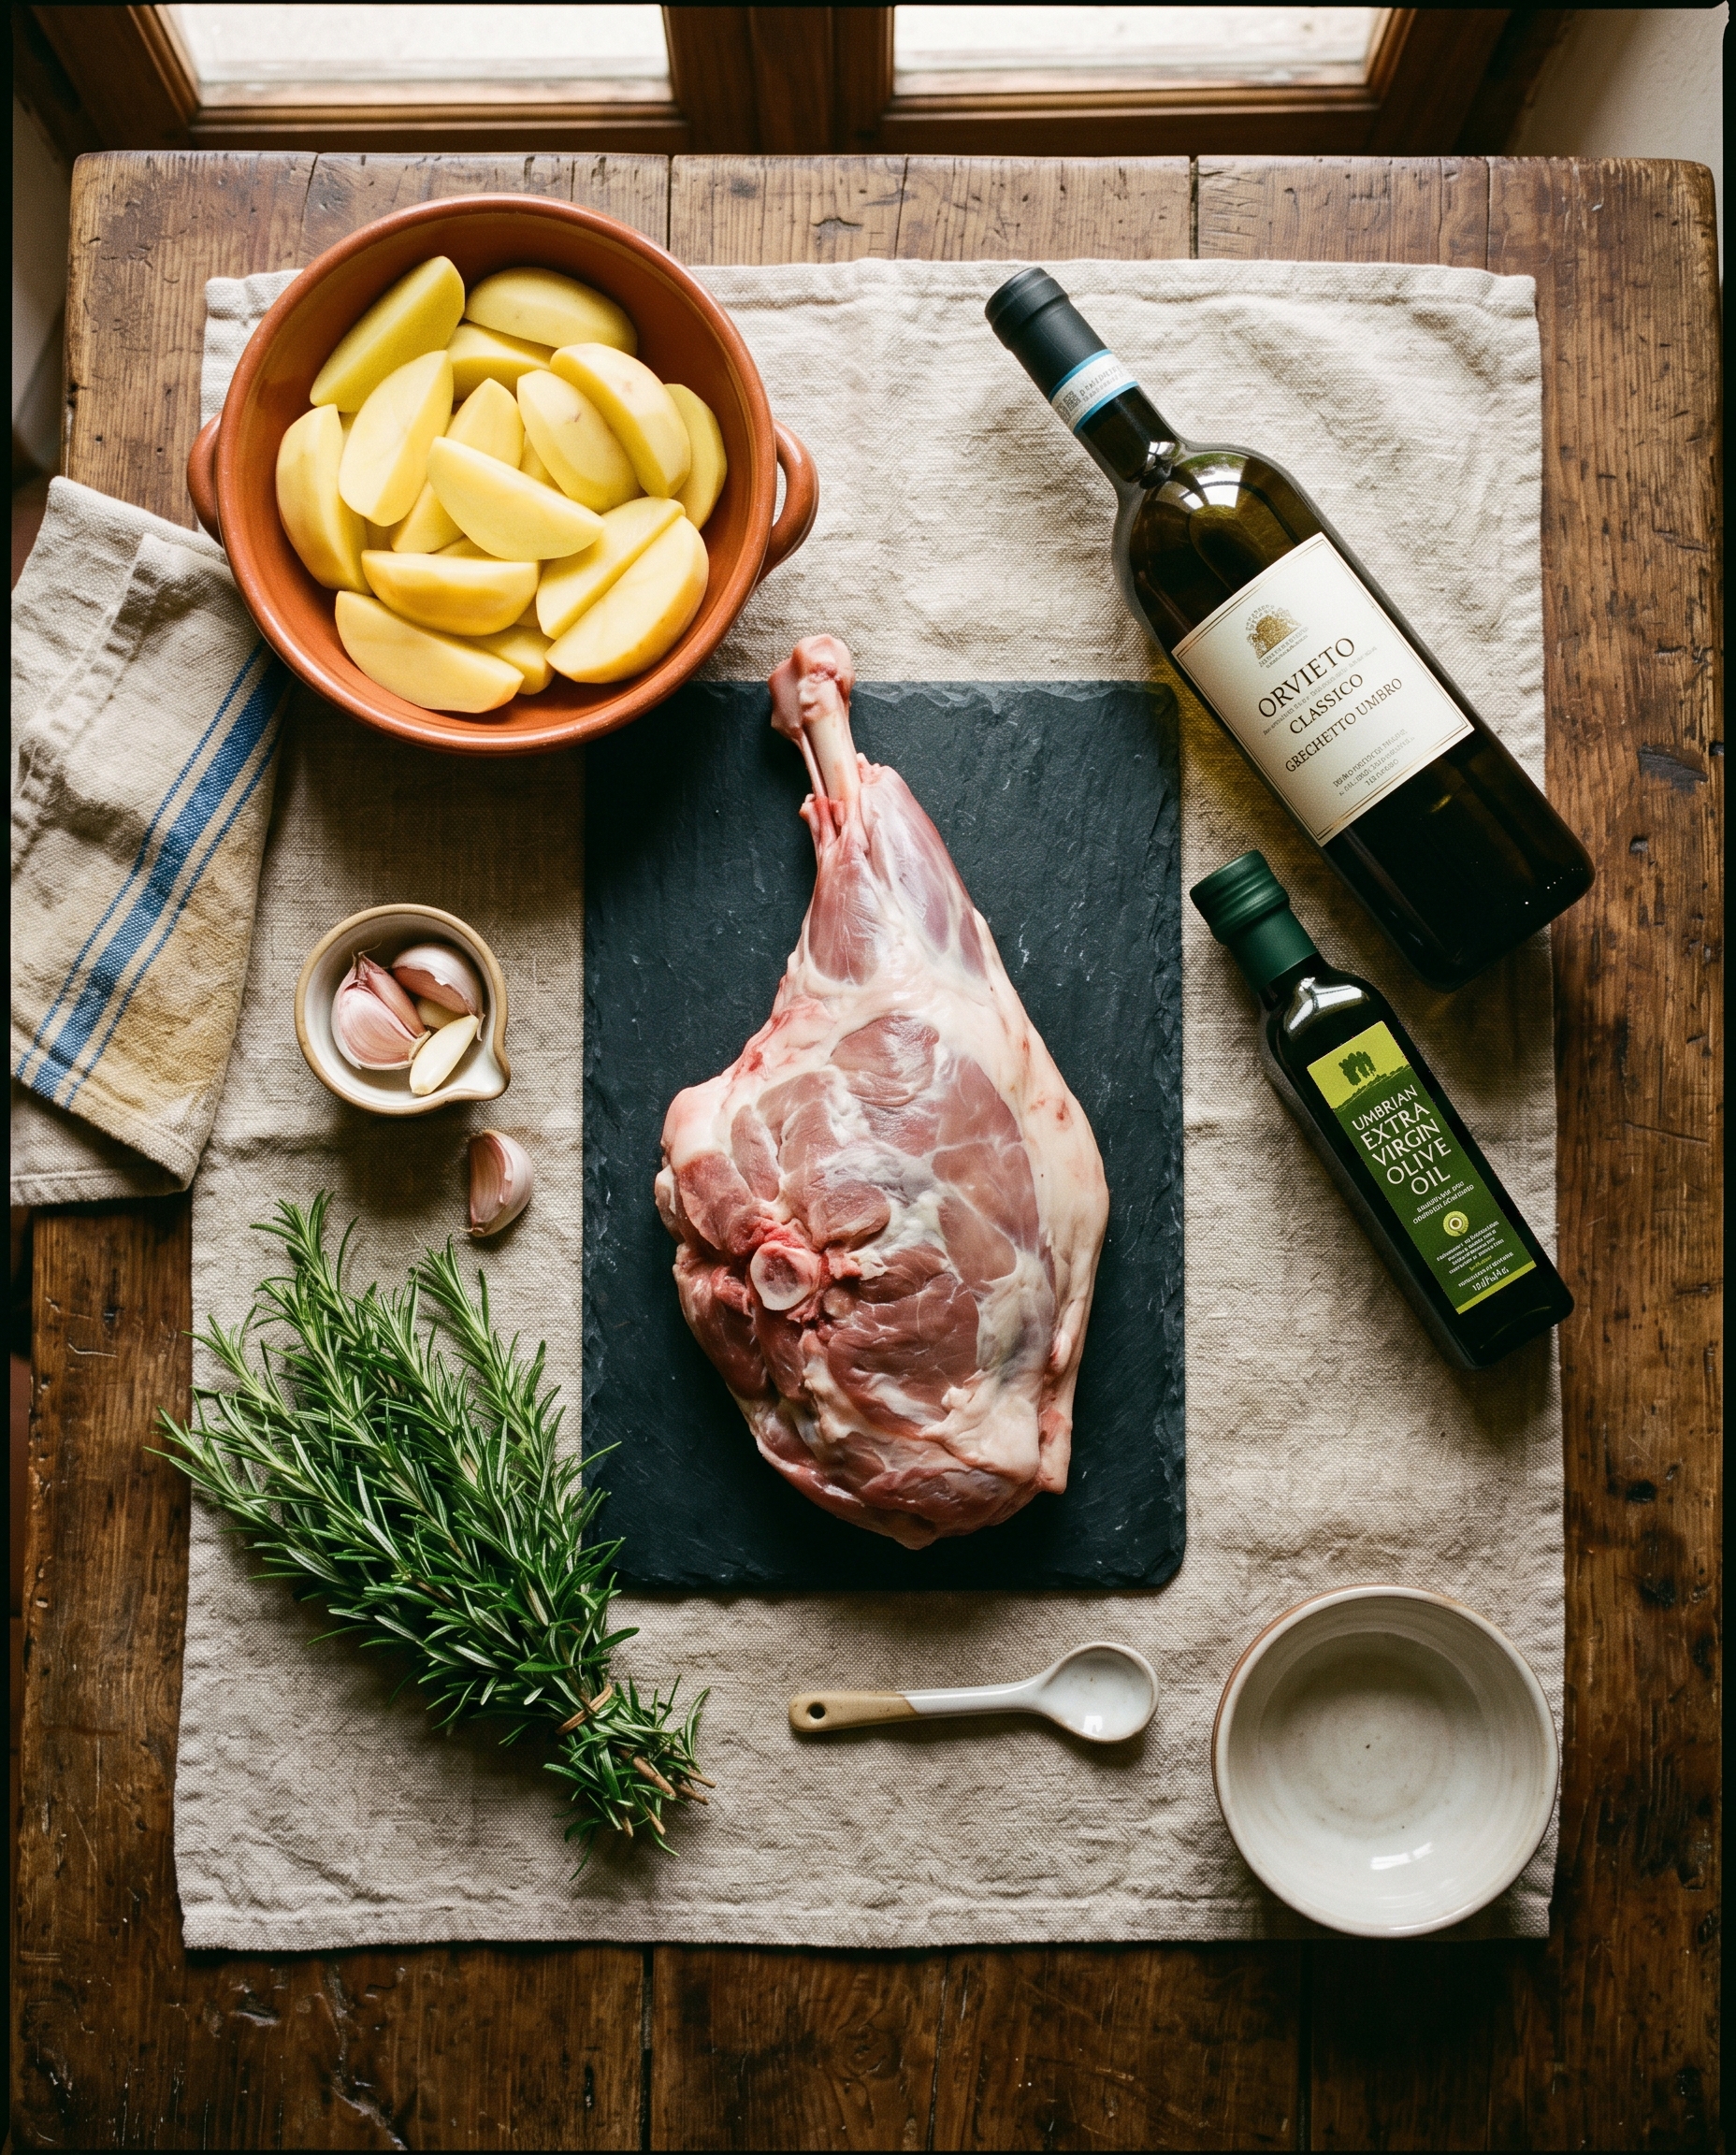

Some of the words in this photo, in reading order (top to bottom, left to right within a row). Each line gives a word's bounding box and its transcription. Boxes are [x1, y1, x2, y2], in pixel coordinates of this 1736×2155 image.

[1258, 638, 1355, 717] ORVIETO
[1285, 712, 1356, 773] GRECHETTO
[1355, 677, 1402, 716] UMBRO
[1289, 673, 1364, 734] CLASSICO
[1352, 1085, 1418, 1131] UMBRIAN
[1360, 1102, 1430, 1150] EXTRA
[1371, 1118, 1440, 1167] VIRGIN
[1386, 1137, 1452, 1185] OLIVE
[1410, 1165, 1451, 1195] OIL
